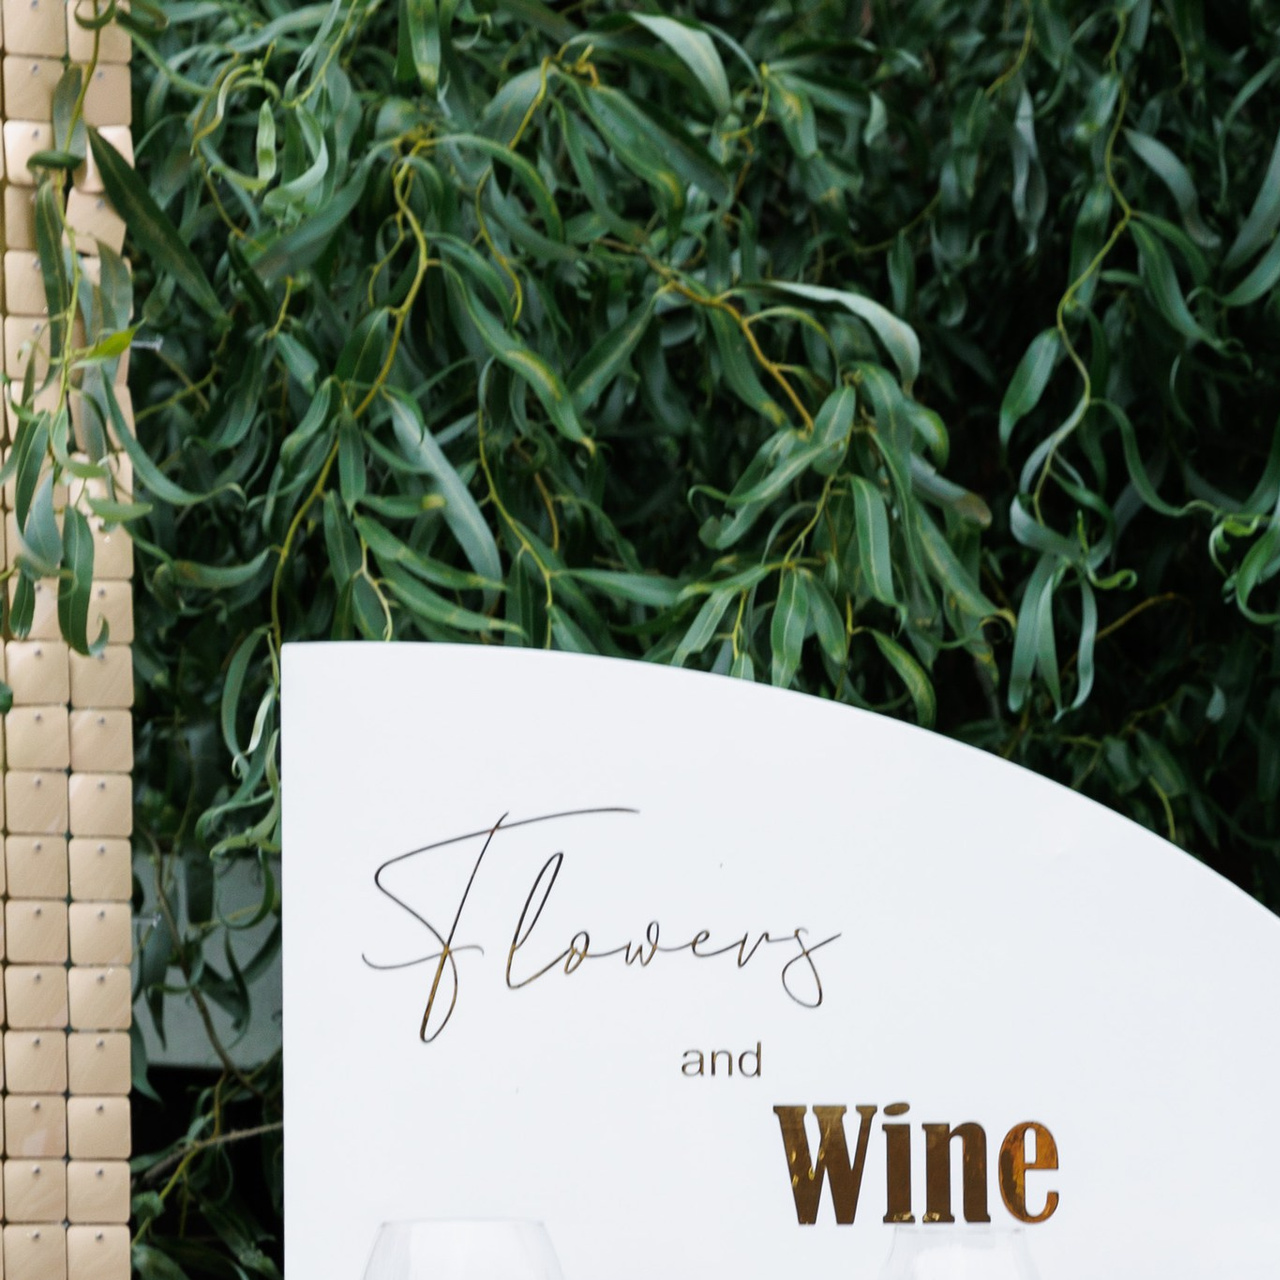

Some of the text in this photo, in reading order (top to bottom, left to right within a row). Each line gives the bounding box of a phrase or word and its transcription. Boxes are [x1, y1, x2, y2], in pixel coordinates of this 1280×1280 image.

[361, 807, 843, 1044] Flowers
[681, 1040, 763, 1079] and
[772, 1101, 1061, 1227] Wine
